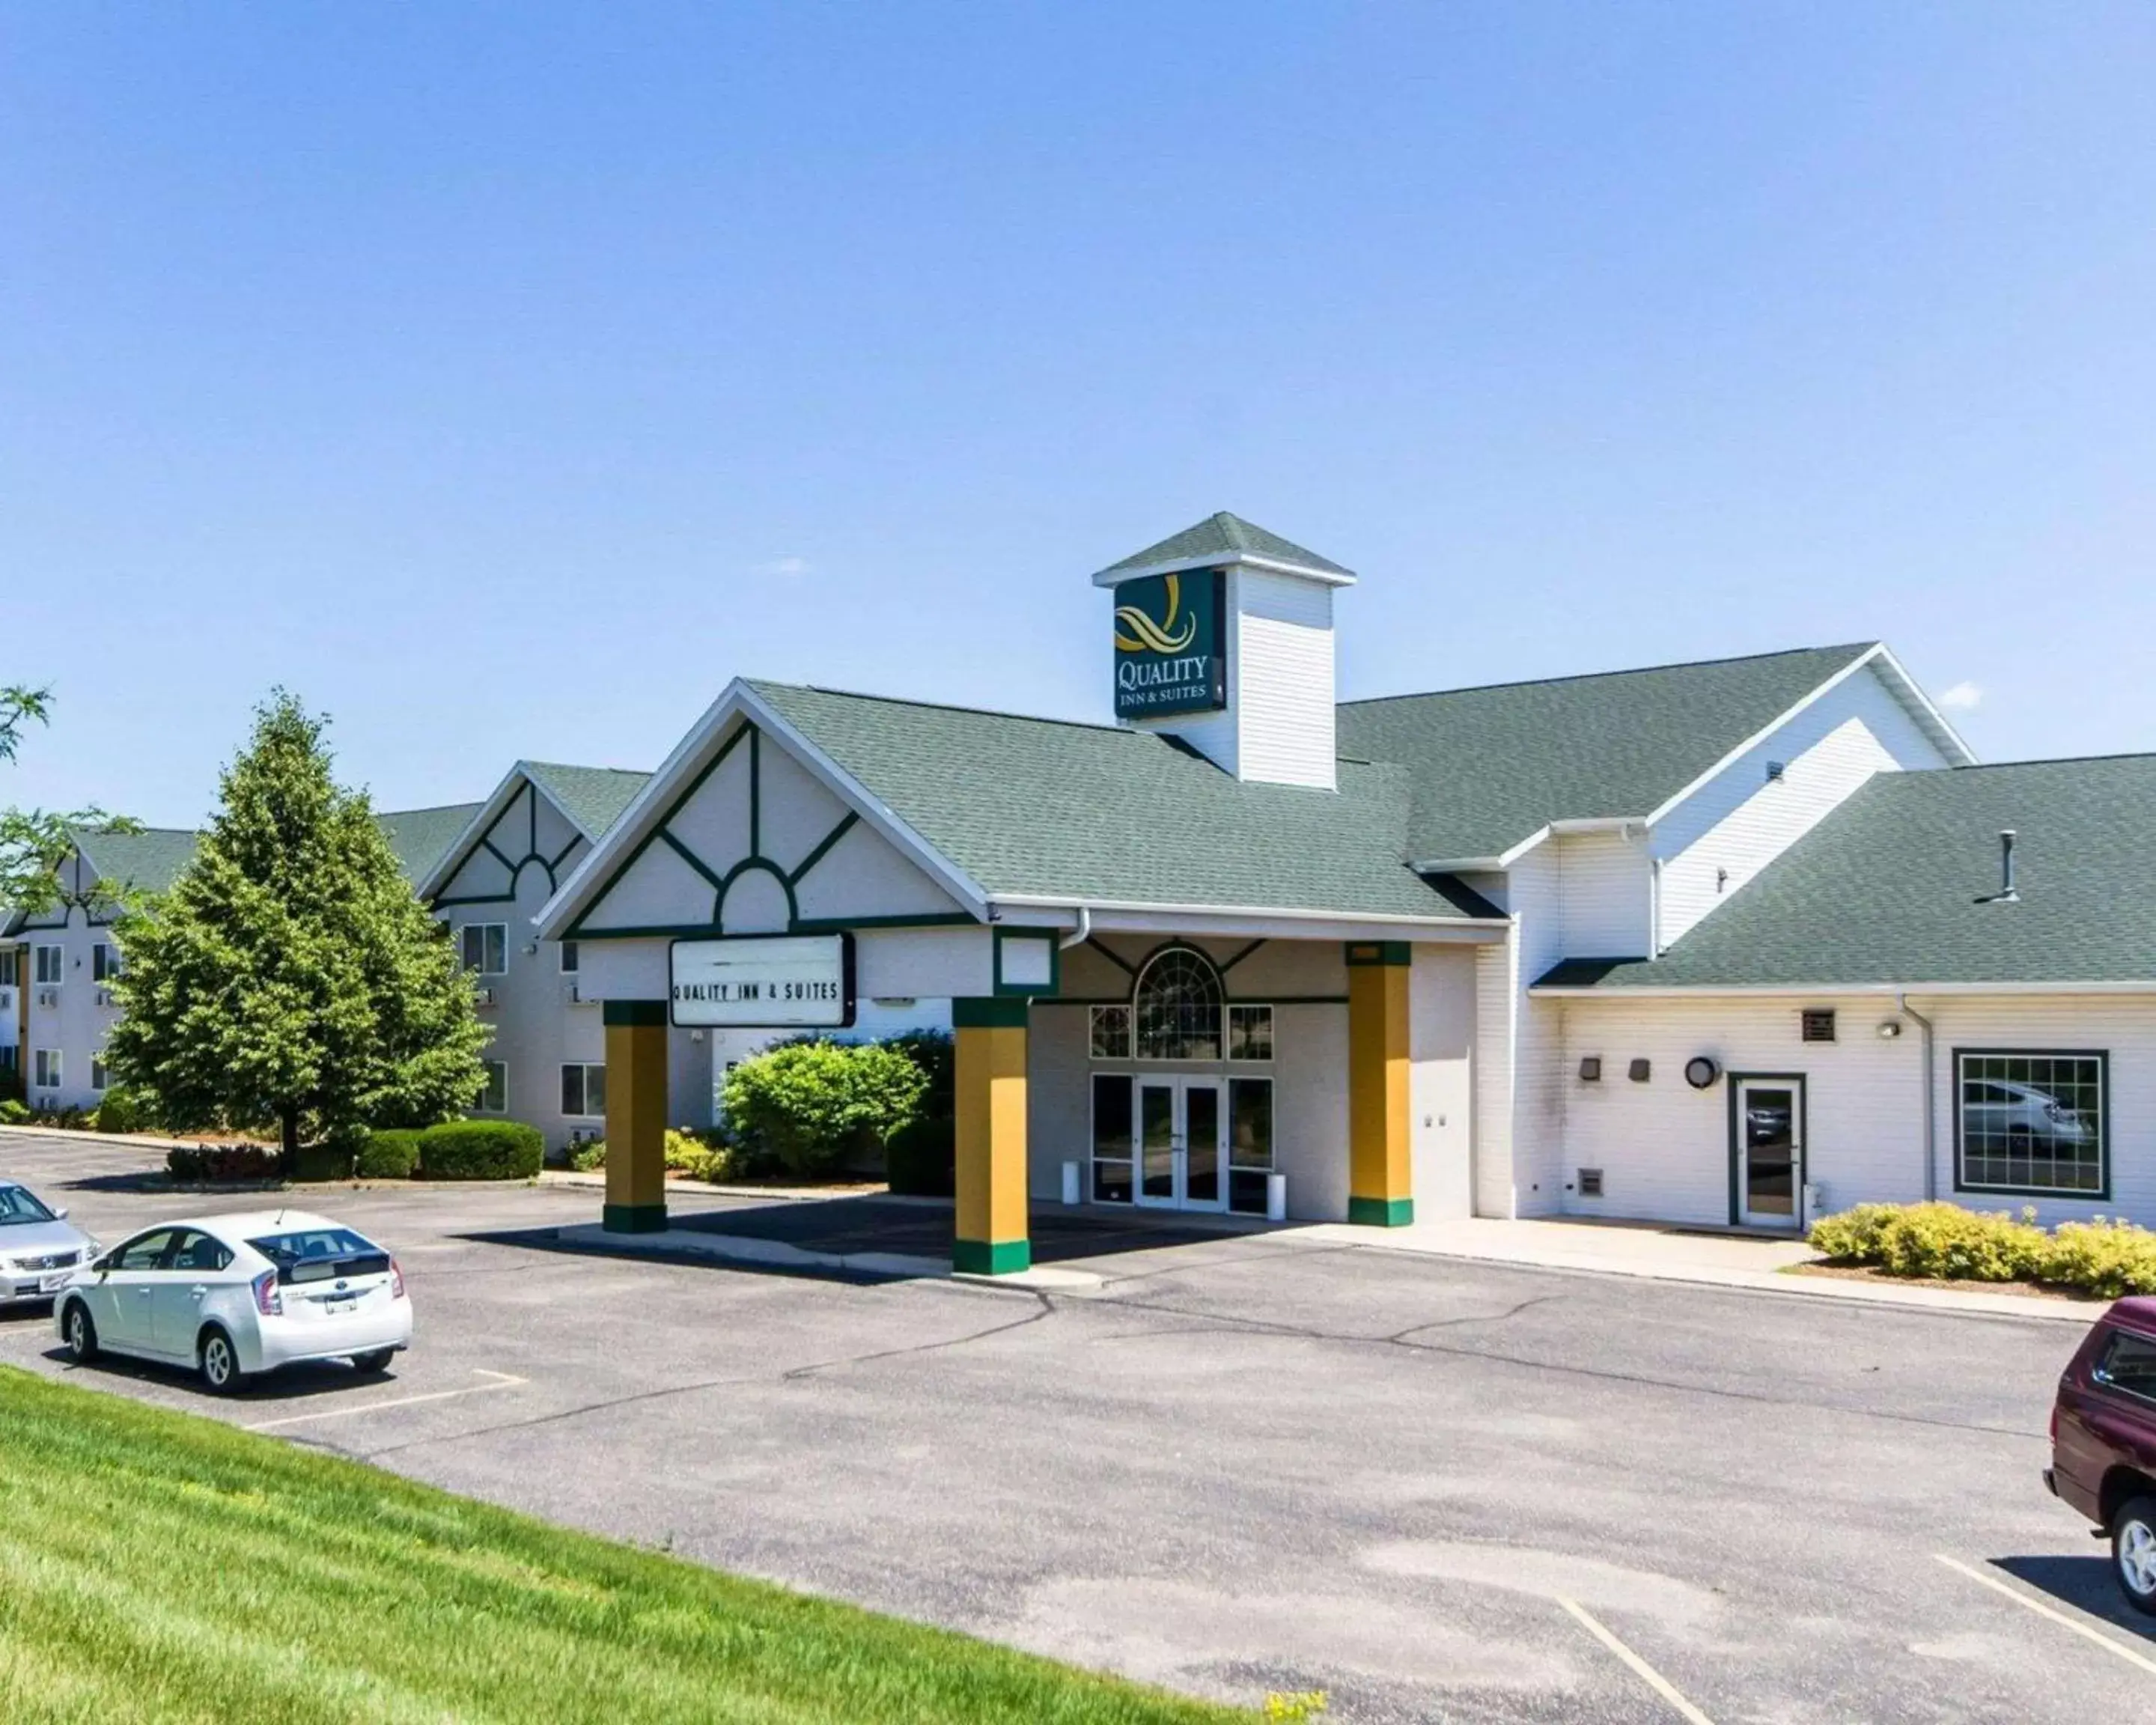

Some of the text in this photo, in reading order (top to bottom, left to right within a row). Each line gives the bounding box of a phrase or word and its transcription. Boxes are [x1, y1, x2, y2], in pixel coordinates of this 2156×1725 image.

[1119, 656, 1208, 690] QUALITY
[1121, 685, 1206, 706] INN & SUITES
[674, 982, 837, 1000] QUALITY INN & SUITES
